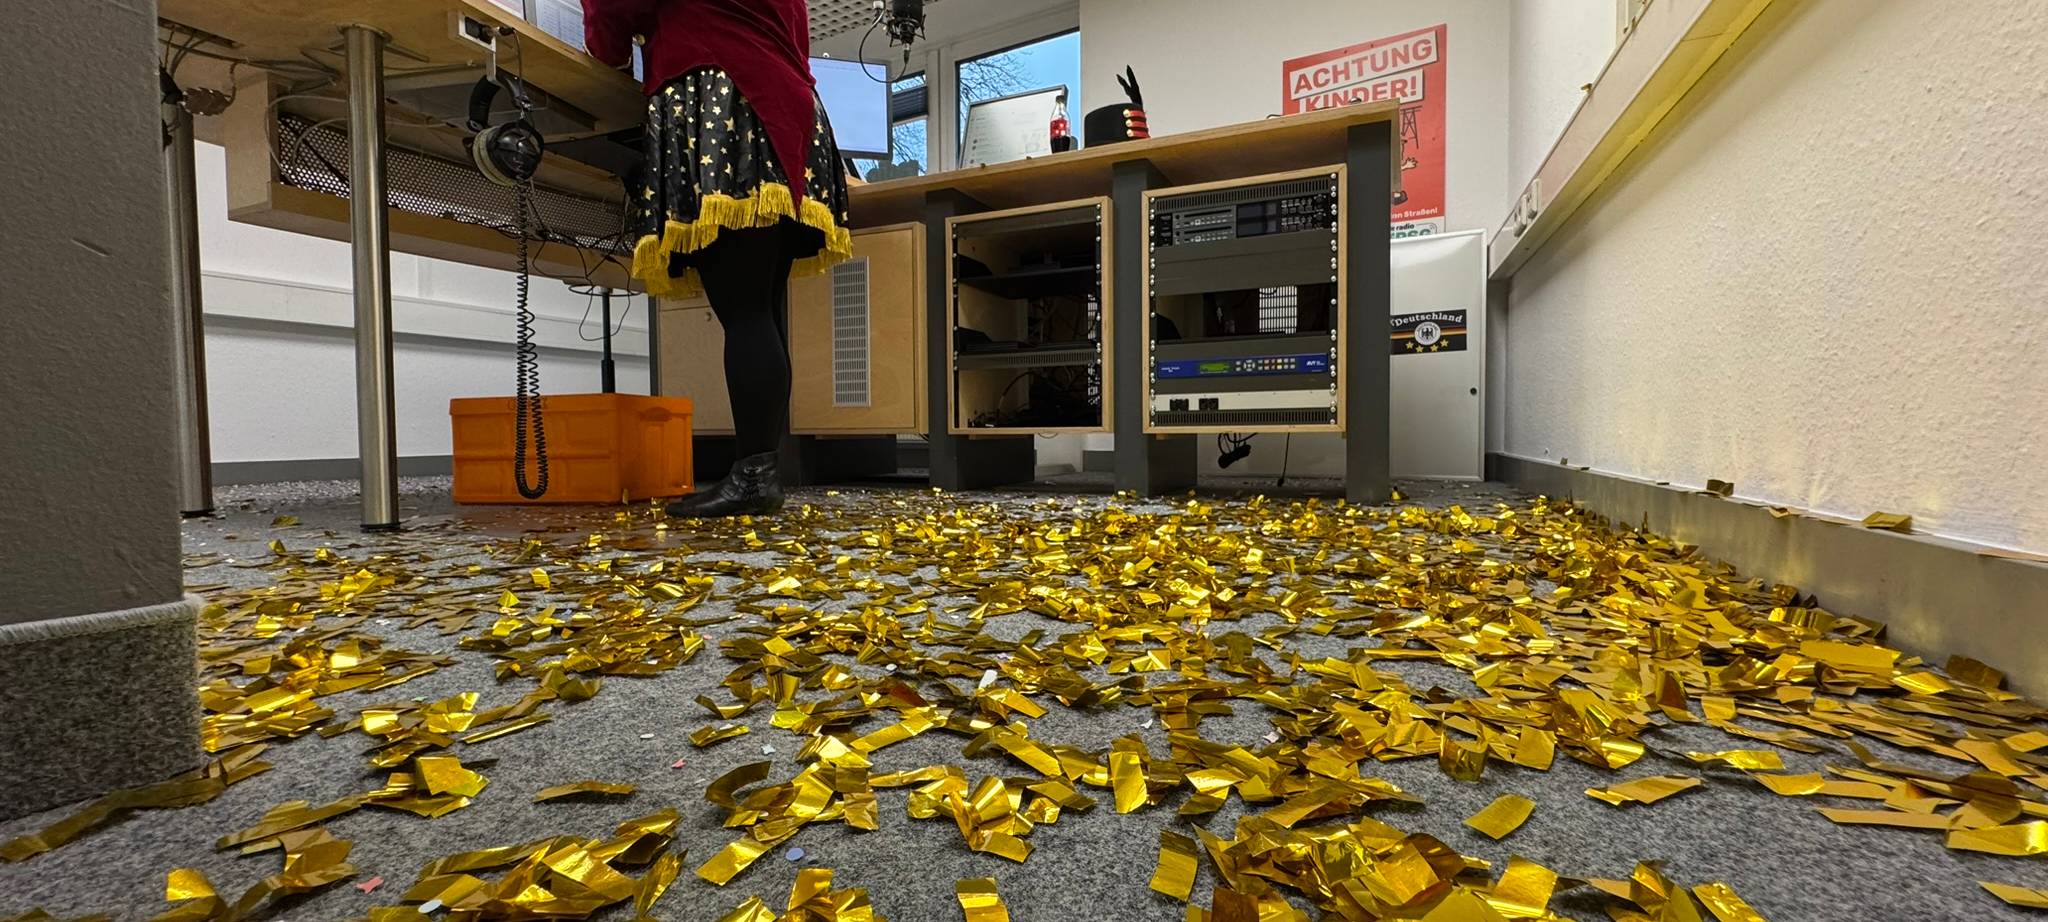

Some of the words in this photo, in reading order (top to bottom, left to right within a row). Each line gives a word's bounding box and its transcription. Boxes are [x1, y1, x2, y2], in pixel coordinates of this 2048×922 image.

[1294, 38, 1433, 95] ACHTUNG
[1396, 223, 1415, 231] radio
[1395, 312, 1463, 327] Deutschland
